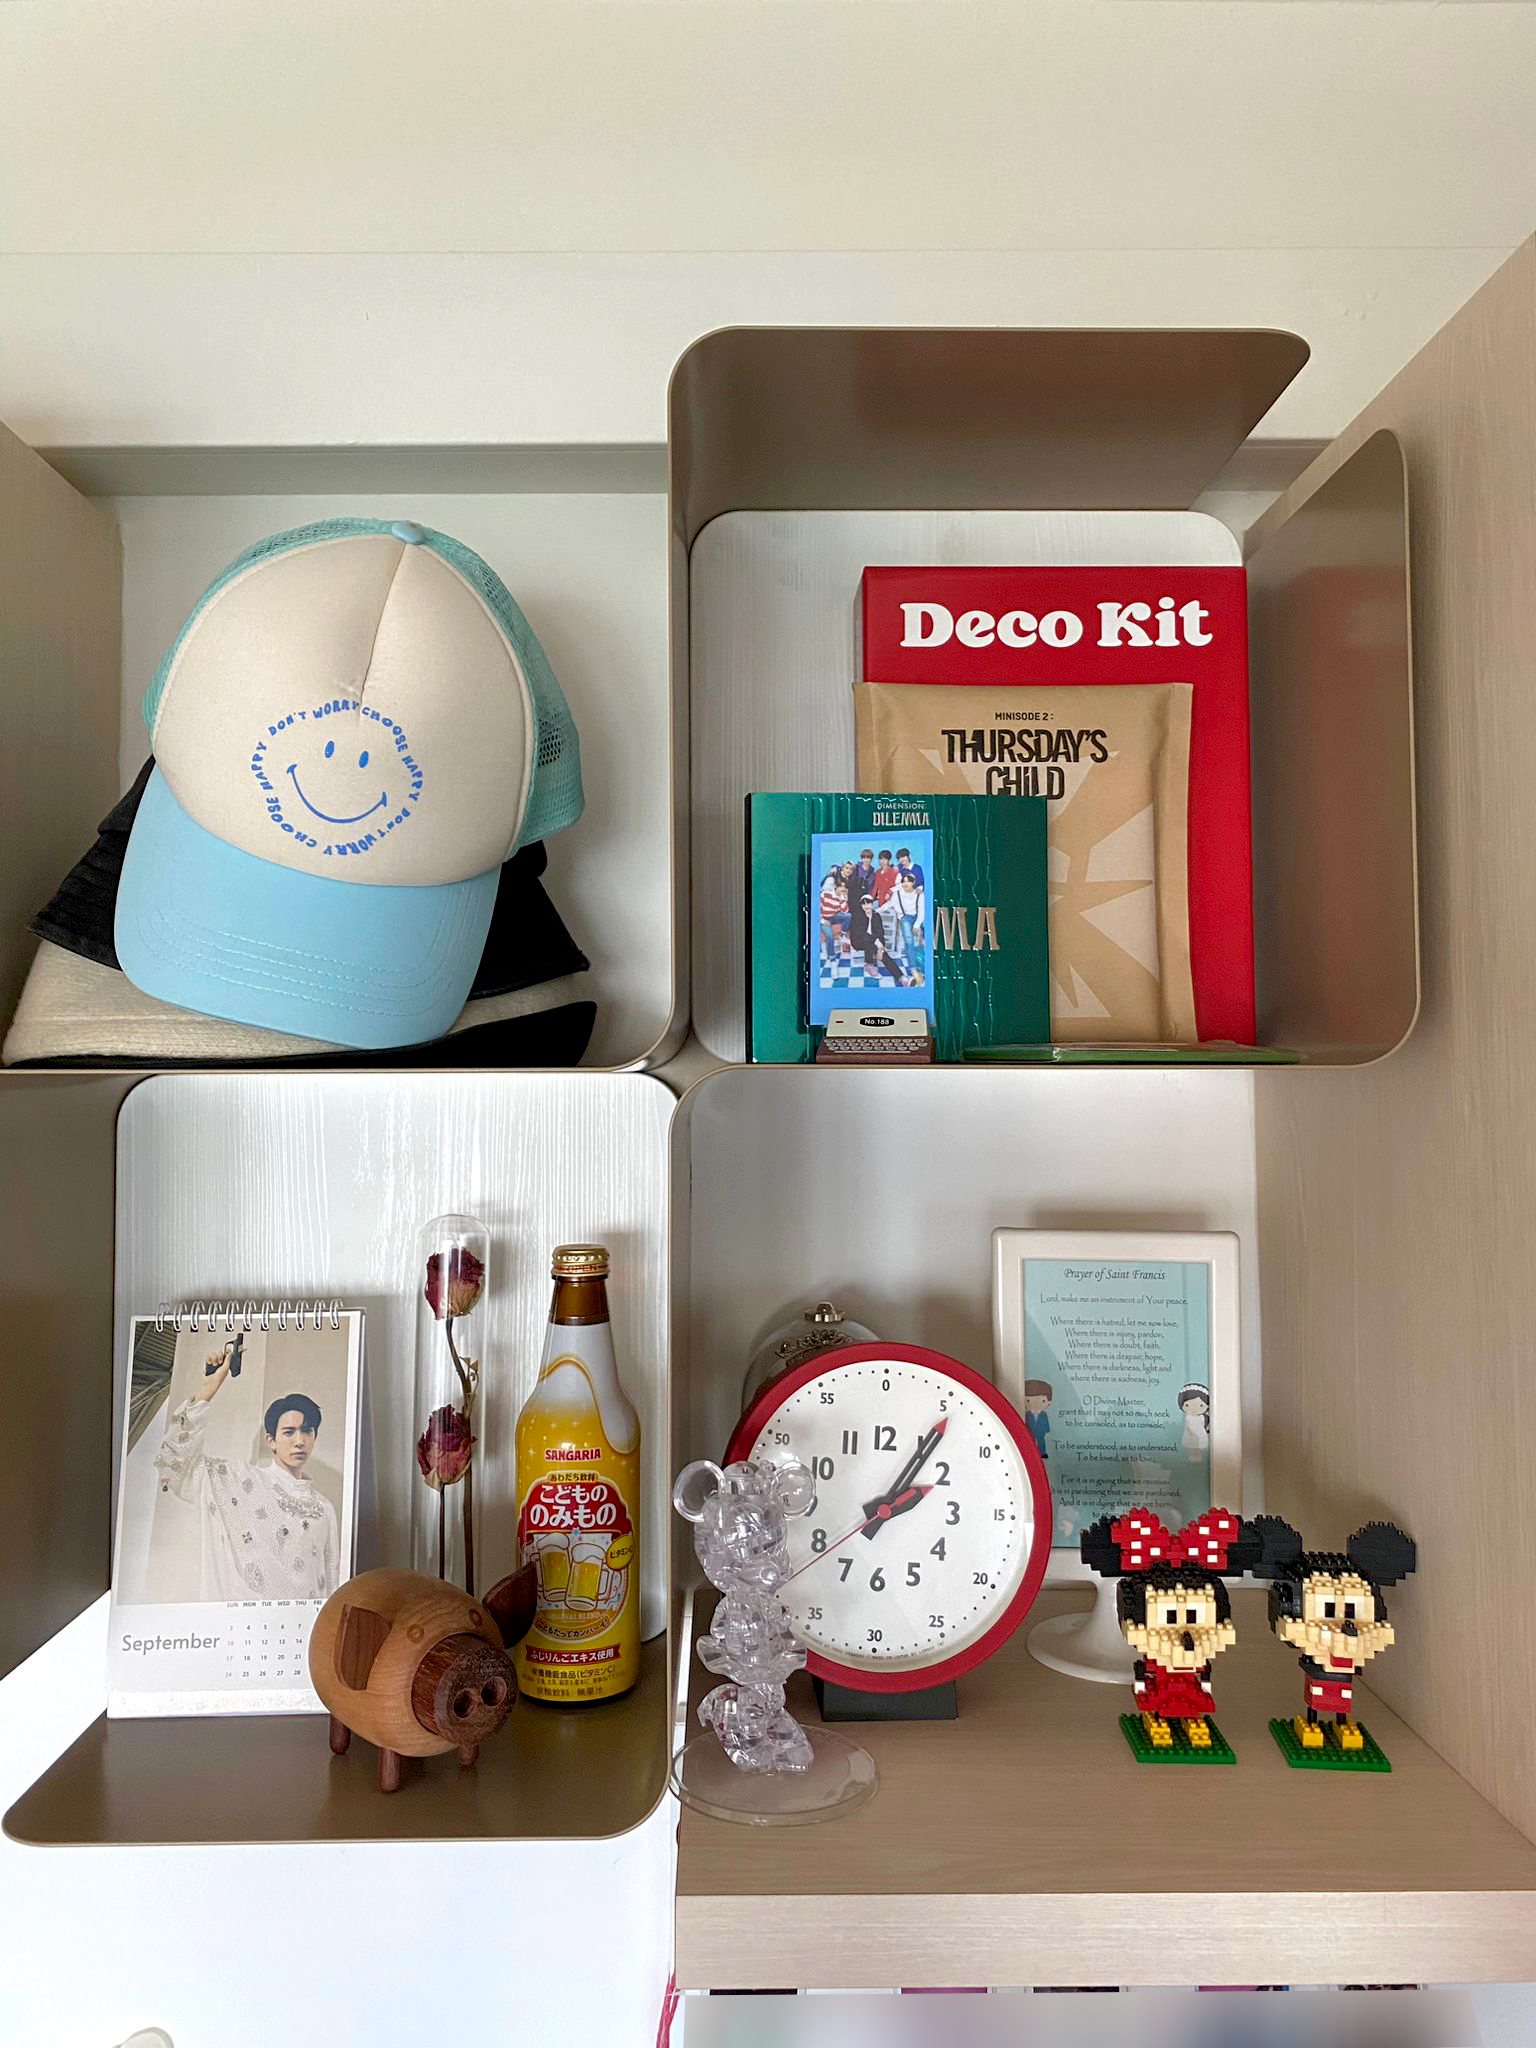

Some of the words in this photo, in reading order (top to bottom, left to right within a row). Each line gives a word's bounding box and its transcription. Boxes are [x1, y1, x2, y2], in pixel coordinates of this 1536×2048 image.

[899, 601, 1083, 648] Deco
[1097, 597, 1213, 647] Kit
[313, 700, 359, 719] WORRY
[995, 712, 1041, 721] MINISODE
[268, 711, 307, 735] DON'T
[362, 706, 408, 752] CHOOSE
[941, 729, 1108, 763] THURSDAY'S
[251, 742, 274, 790] HAPPY
[401, 756, 423, 801] HAPPY
[986, 766, 1065, 800] CHILD
[266, 797, 317, 847] CHOOSE
[377, 807, 410, 838] DON'T
[873, 812, 930, 826] DILEMMA
[323, 834, 376, 856] WORRY
[1064, 1268, 1092, 1281] Prayer
[1095, 1267, 1107, 1281] of
[1106, 1269, 1129, 1279] Saint
[1133, 1270, 1165, 1280] Francis
[1146, 1296, 1164, 1304] Your
[1051, 1317, 1074, 1325] Where
[1127, 1318, 1136, 1326] let
[1065, 1328, 1088, 1337] Where
[1138, 1331, 1164, 1339] pardon,
[1069, 1339, 1091, 1348] Where
[1065, 1351, 1088, 1359] Where
[1116, 1353, 1143, 1363] despair,
[1145, 1353, 1164, 1363] hope,
[1058, 1362, 1081, 1371] Where
[1109, 1363, 1141, 1372] darkness,
[1143, 1364, 1158, 1374] light
[1159, 1364, 1171, 1372] and
[883, 1380, 890, 1391] 0
[820, 1393, 834, 1404] 55
[940, 1400, 947, 1411] 5
[1083, 1395, 1092, 1405] O
[1094, 1396, 1116, 1405] Divine
[1118, 1397, 1145, 1407] Master,
[1059, 1409, 1077, 1418] grant
[1078, 1408, 1092, 1416] that
[1085, 1420, 1117, 1428] consoled,
[775, 1433, 789, 1445] 50
[842, 1431, 858, 1454] 11
[874, 1425, 897, 1451] 12
[1053, 1440, 1065, 1450] To
[1067, 1441, 1075, 1449] be
[546, 1449, 601, 1460] SANGARIA
[979, 1447, 991, 1458] 10
[1077, 1453, 1088, 1461] To
[1090, 1453, 1098, 1461] be
[812, 1456, 834, 1480] 10
[935, 1462, 951, 1486] 2
[540, 1485, 608, 1504] こどもの
[530, 1503, 616, 1528] のみもの
[946, 1501, 960, 1525] 3
[994, 1510, 1005, 1521] 15
[811, 1529, 827, 1553] 8
[930, 1537, 946, 1561] 4
[838, 1558, 853, 1582] 7
[906, 1563, 921, 1586] 5
[869, 1567, 885, 1591] 6
[973, 1573, 988, 1584] 20
[808, 1608, 822, 1620] 35
[929, 1616, 944, 1627] 25
[867, 1630, 882, 1641] 30
[122, 1633, 220, 1655] September
[531, 1648, 613, 1663] ふじりんごエキス使用
